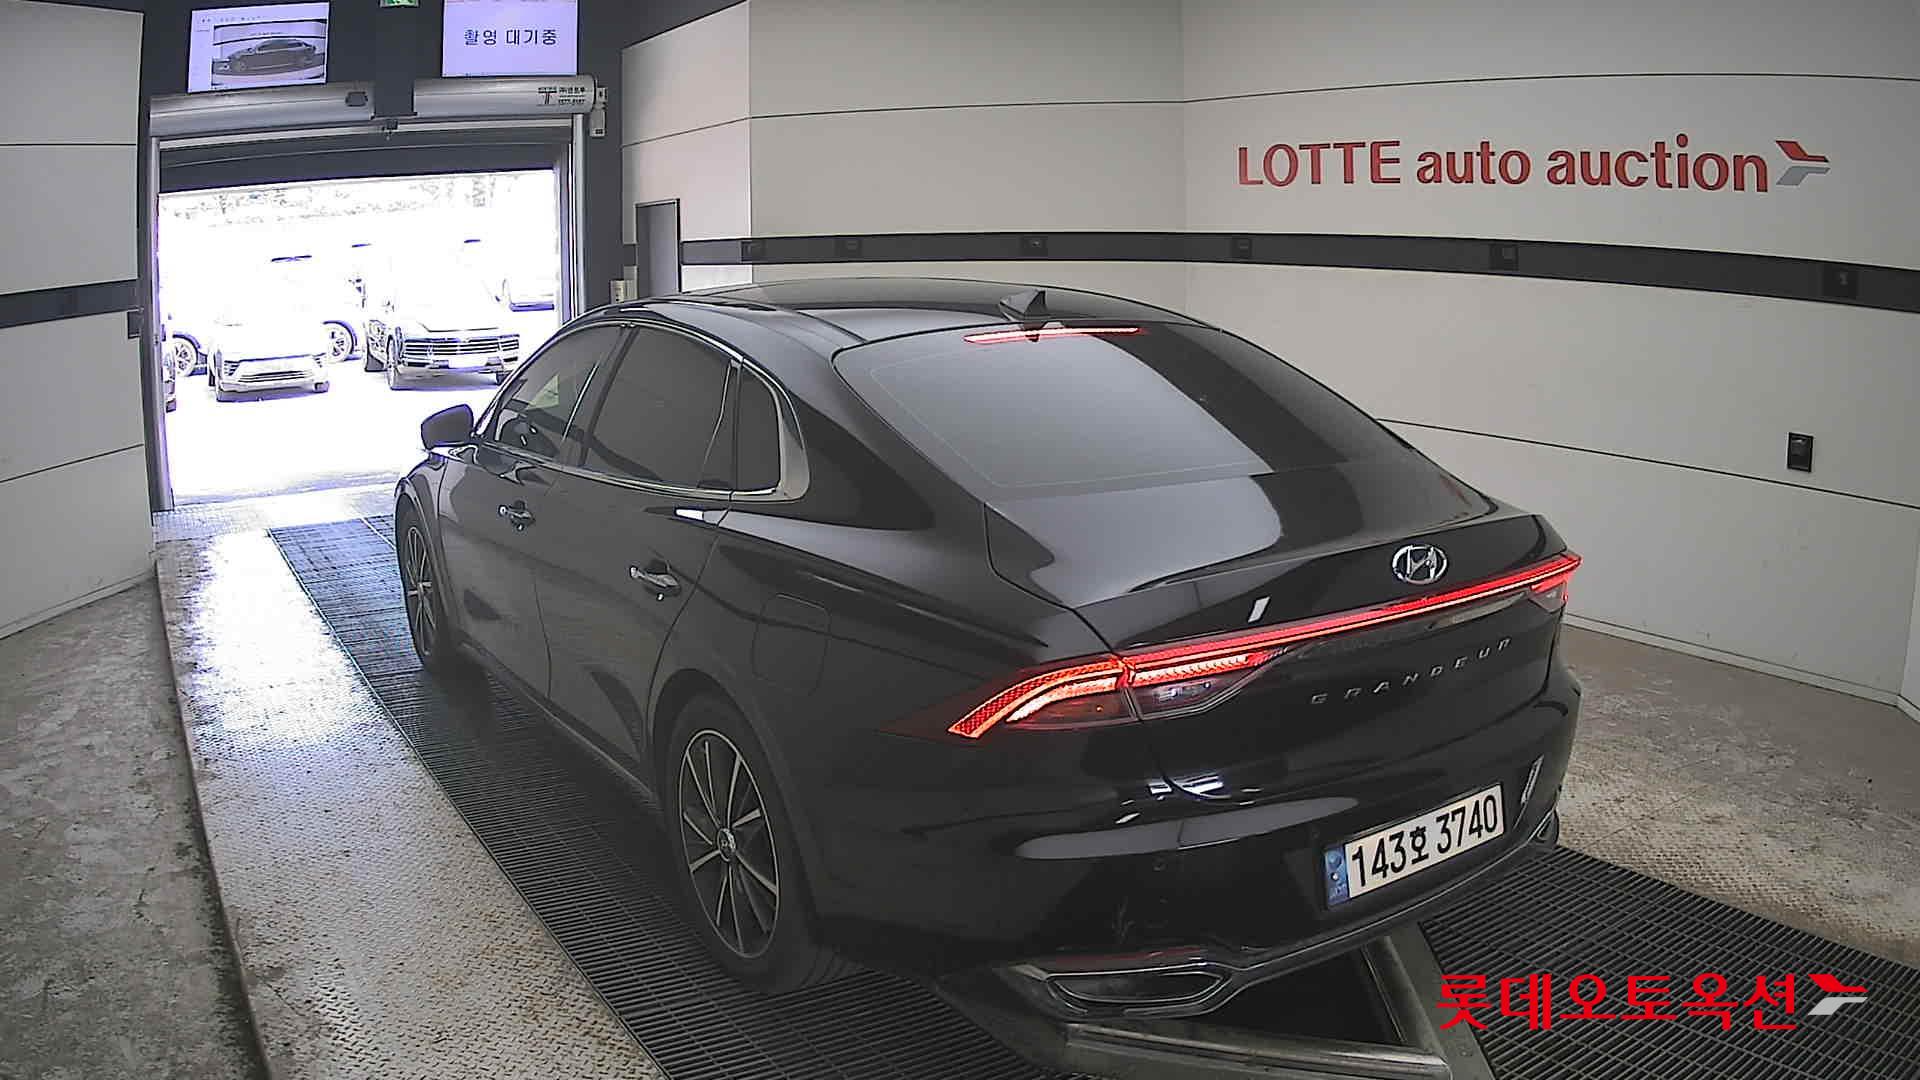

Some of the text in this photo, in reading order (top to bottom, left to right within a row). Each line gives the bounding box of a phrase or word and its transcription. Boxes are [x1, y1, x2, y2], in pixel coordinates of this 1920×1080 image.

[464, 29, 557, 46] 촬영 대기중
[1238, 133, 1769, 192] LOTTE auto auction
[1351, 794, 1498, 887] 143호 3740
